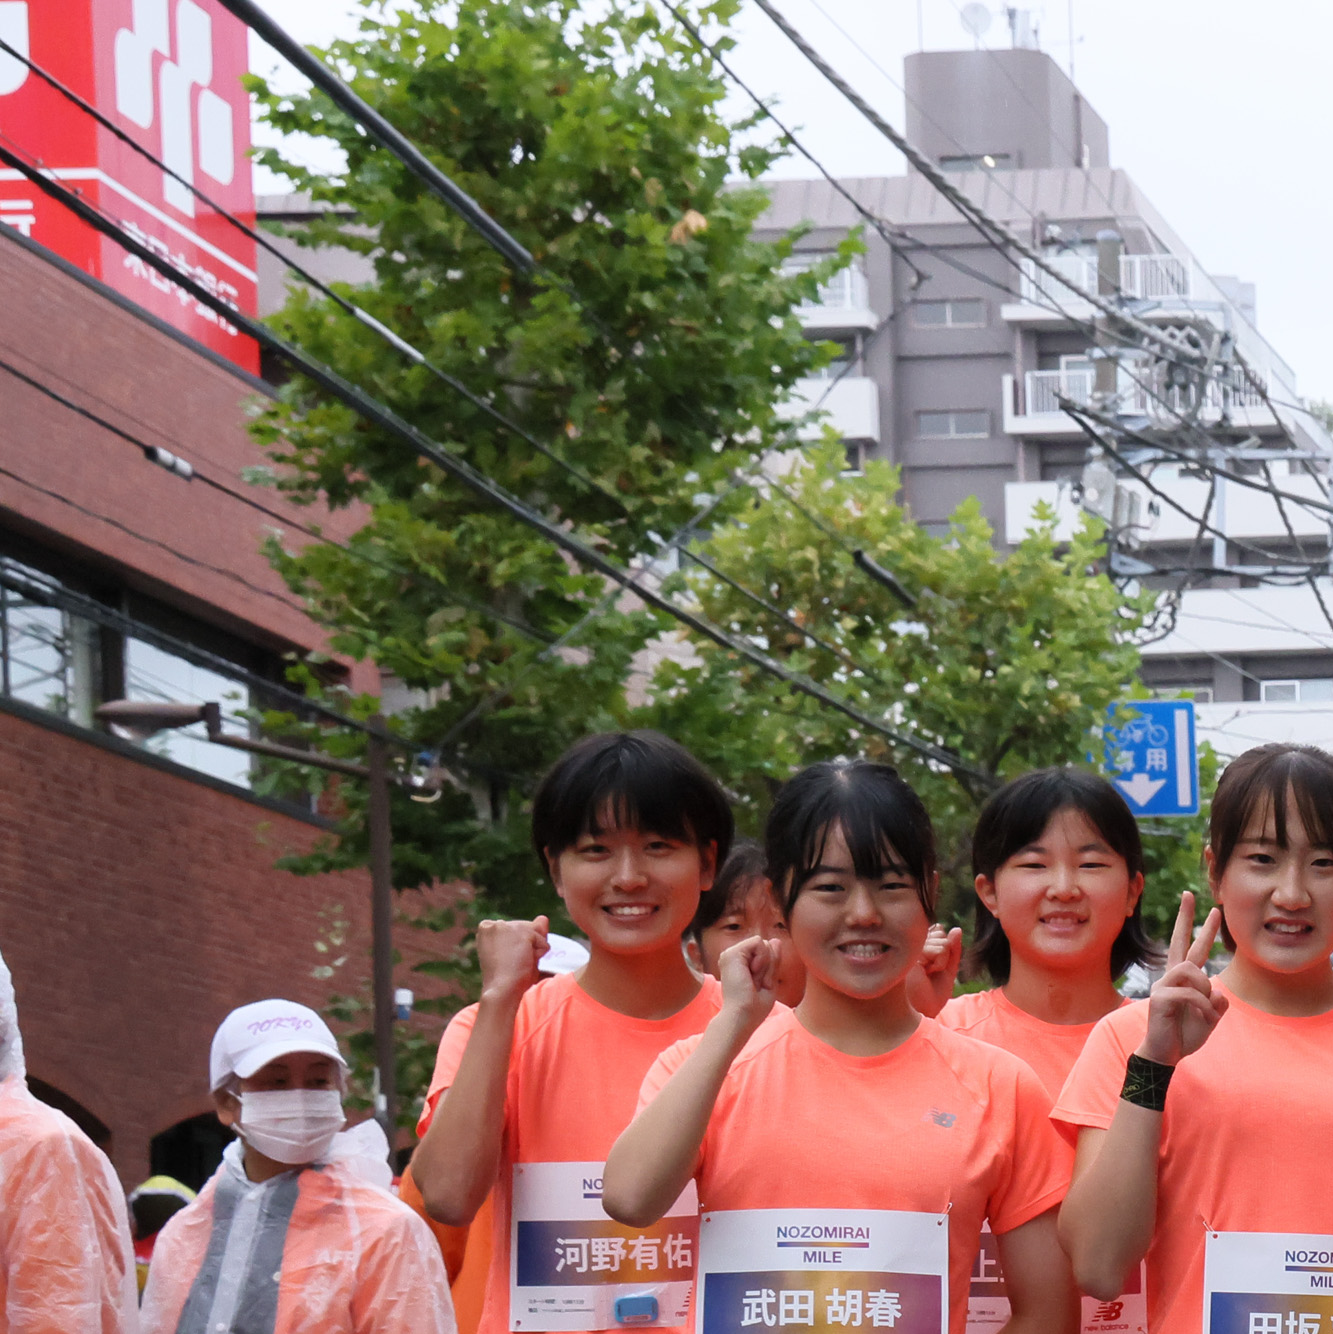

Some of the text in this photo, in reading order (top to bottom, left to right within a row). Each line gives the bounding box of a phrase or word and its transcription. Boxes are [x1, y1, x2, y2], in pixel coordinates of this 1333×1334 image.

[777, 1226, 870, 1239] NOZOMIRAI
[554, 1233, 693, 1273] 河野有佑
[803, 1251, 842, 1263] MILE
[970, 1249, 1005, 1283] 上
[741, 1288, 902, 1328] 武田 胡春
